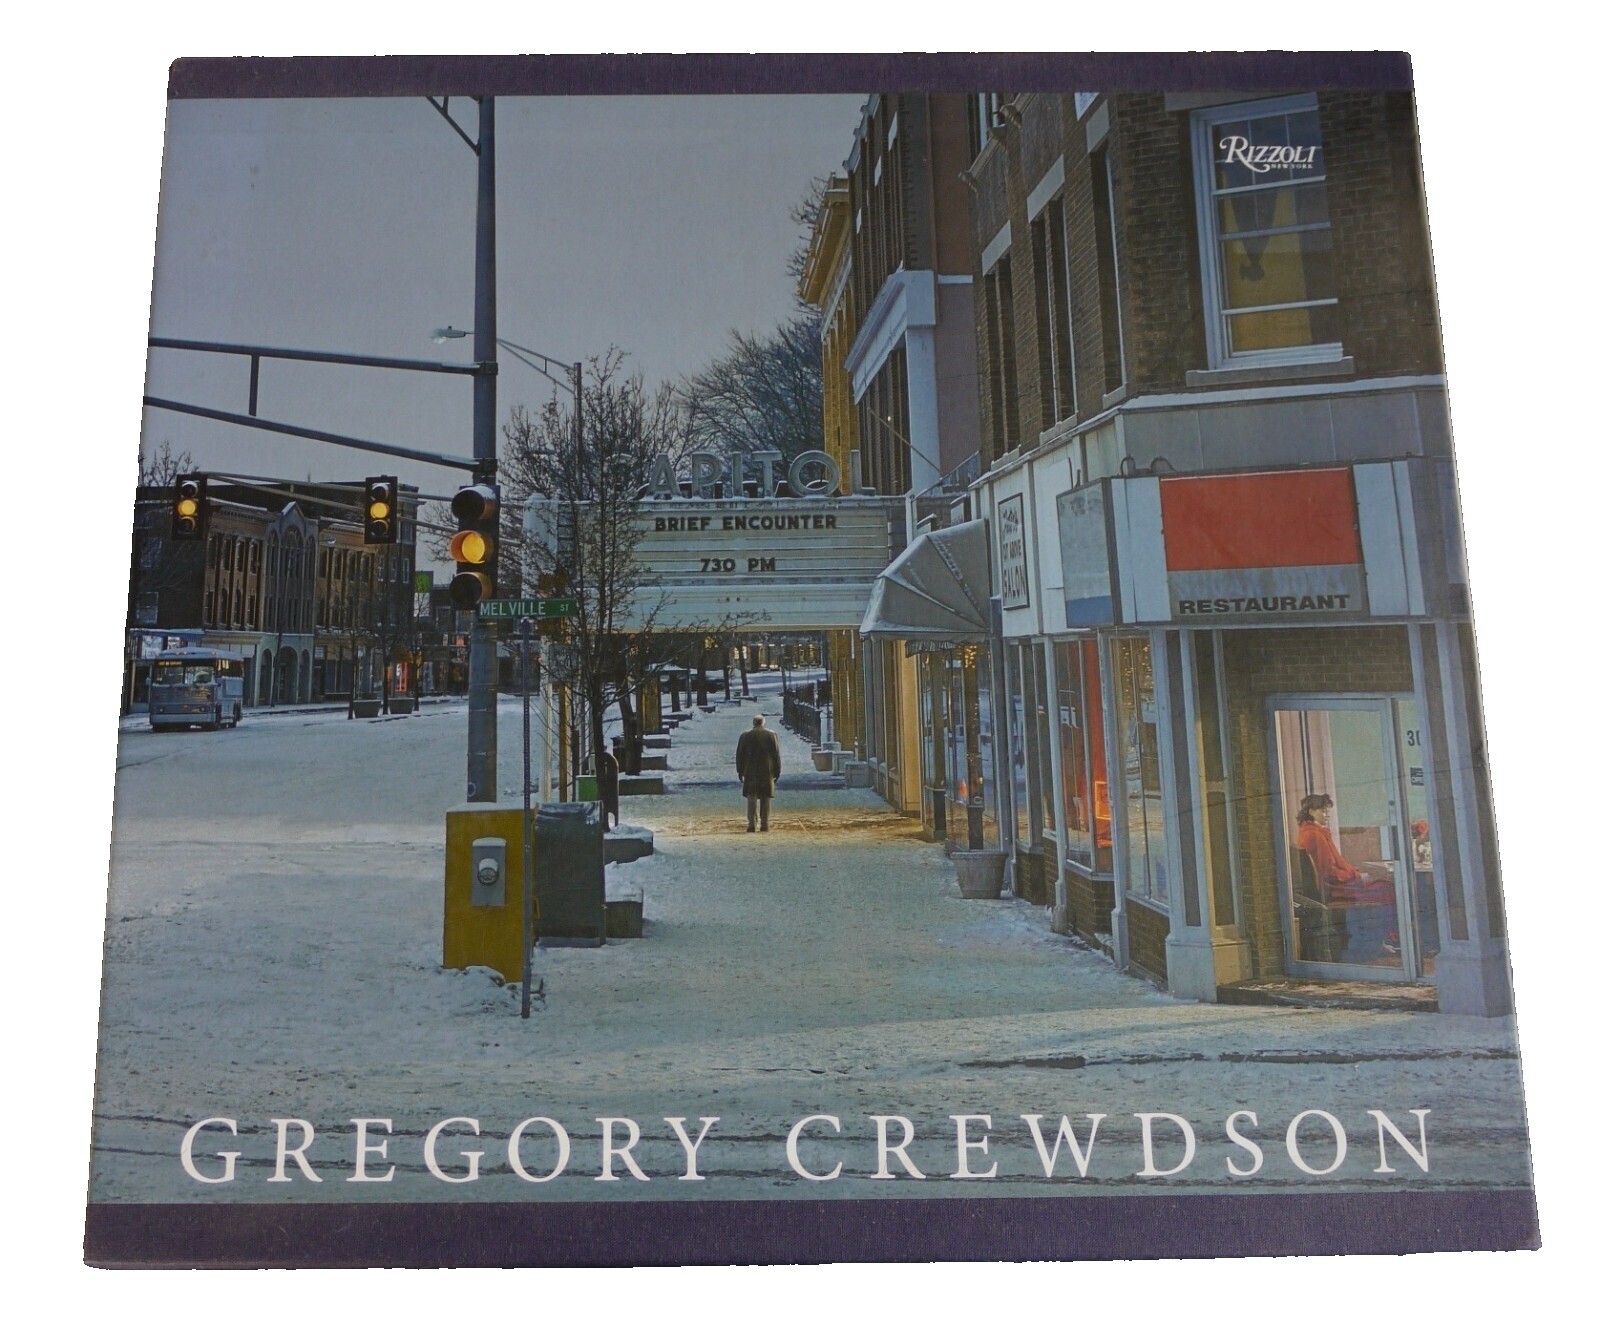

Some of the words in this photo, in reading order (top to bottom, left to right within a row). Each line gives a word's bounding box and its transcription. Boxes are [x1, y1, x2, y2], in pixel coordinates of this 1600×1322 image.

[1219, 136, 1317, 173] RIZZOLI
[655, 516, 712, 532] BRIEF
[722, 514, 838, 531] ENCOUNTER
[701, 558, 736, 573] 730
[748, 557, 776, 572] PM
[480, 601, 546, 616] MELVILLE
[1179, 594, 1350, 614] RESTAURANT
[180, 1115, 720, 1184] GREGORY
[785, 1108, 1432, 1181] CREWDSON
